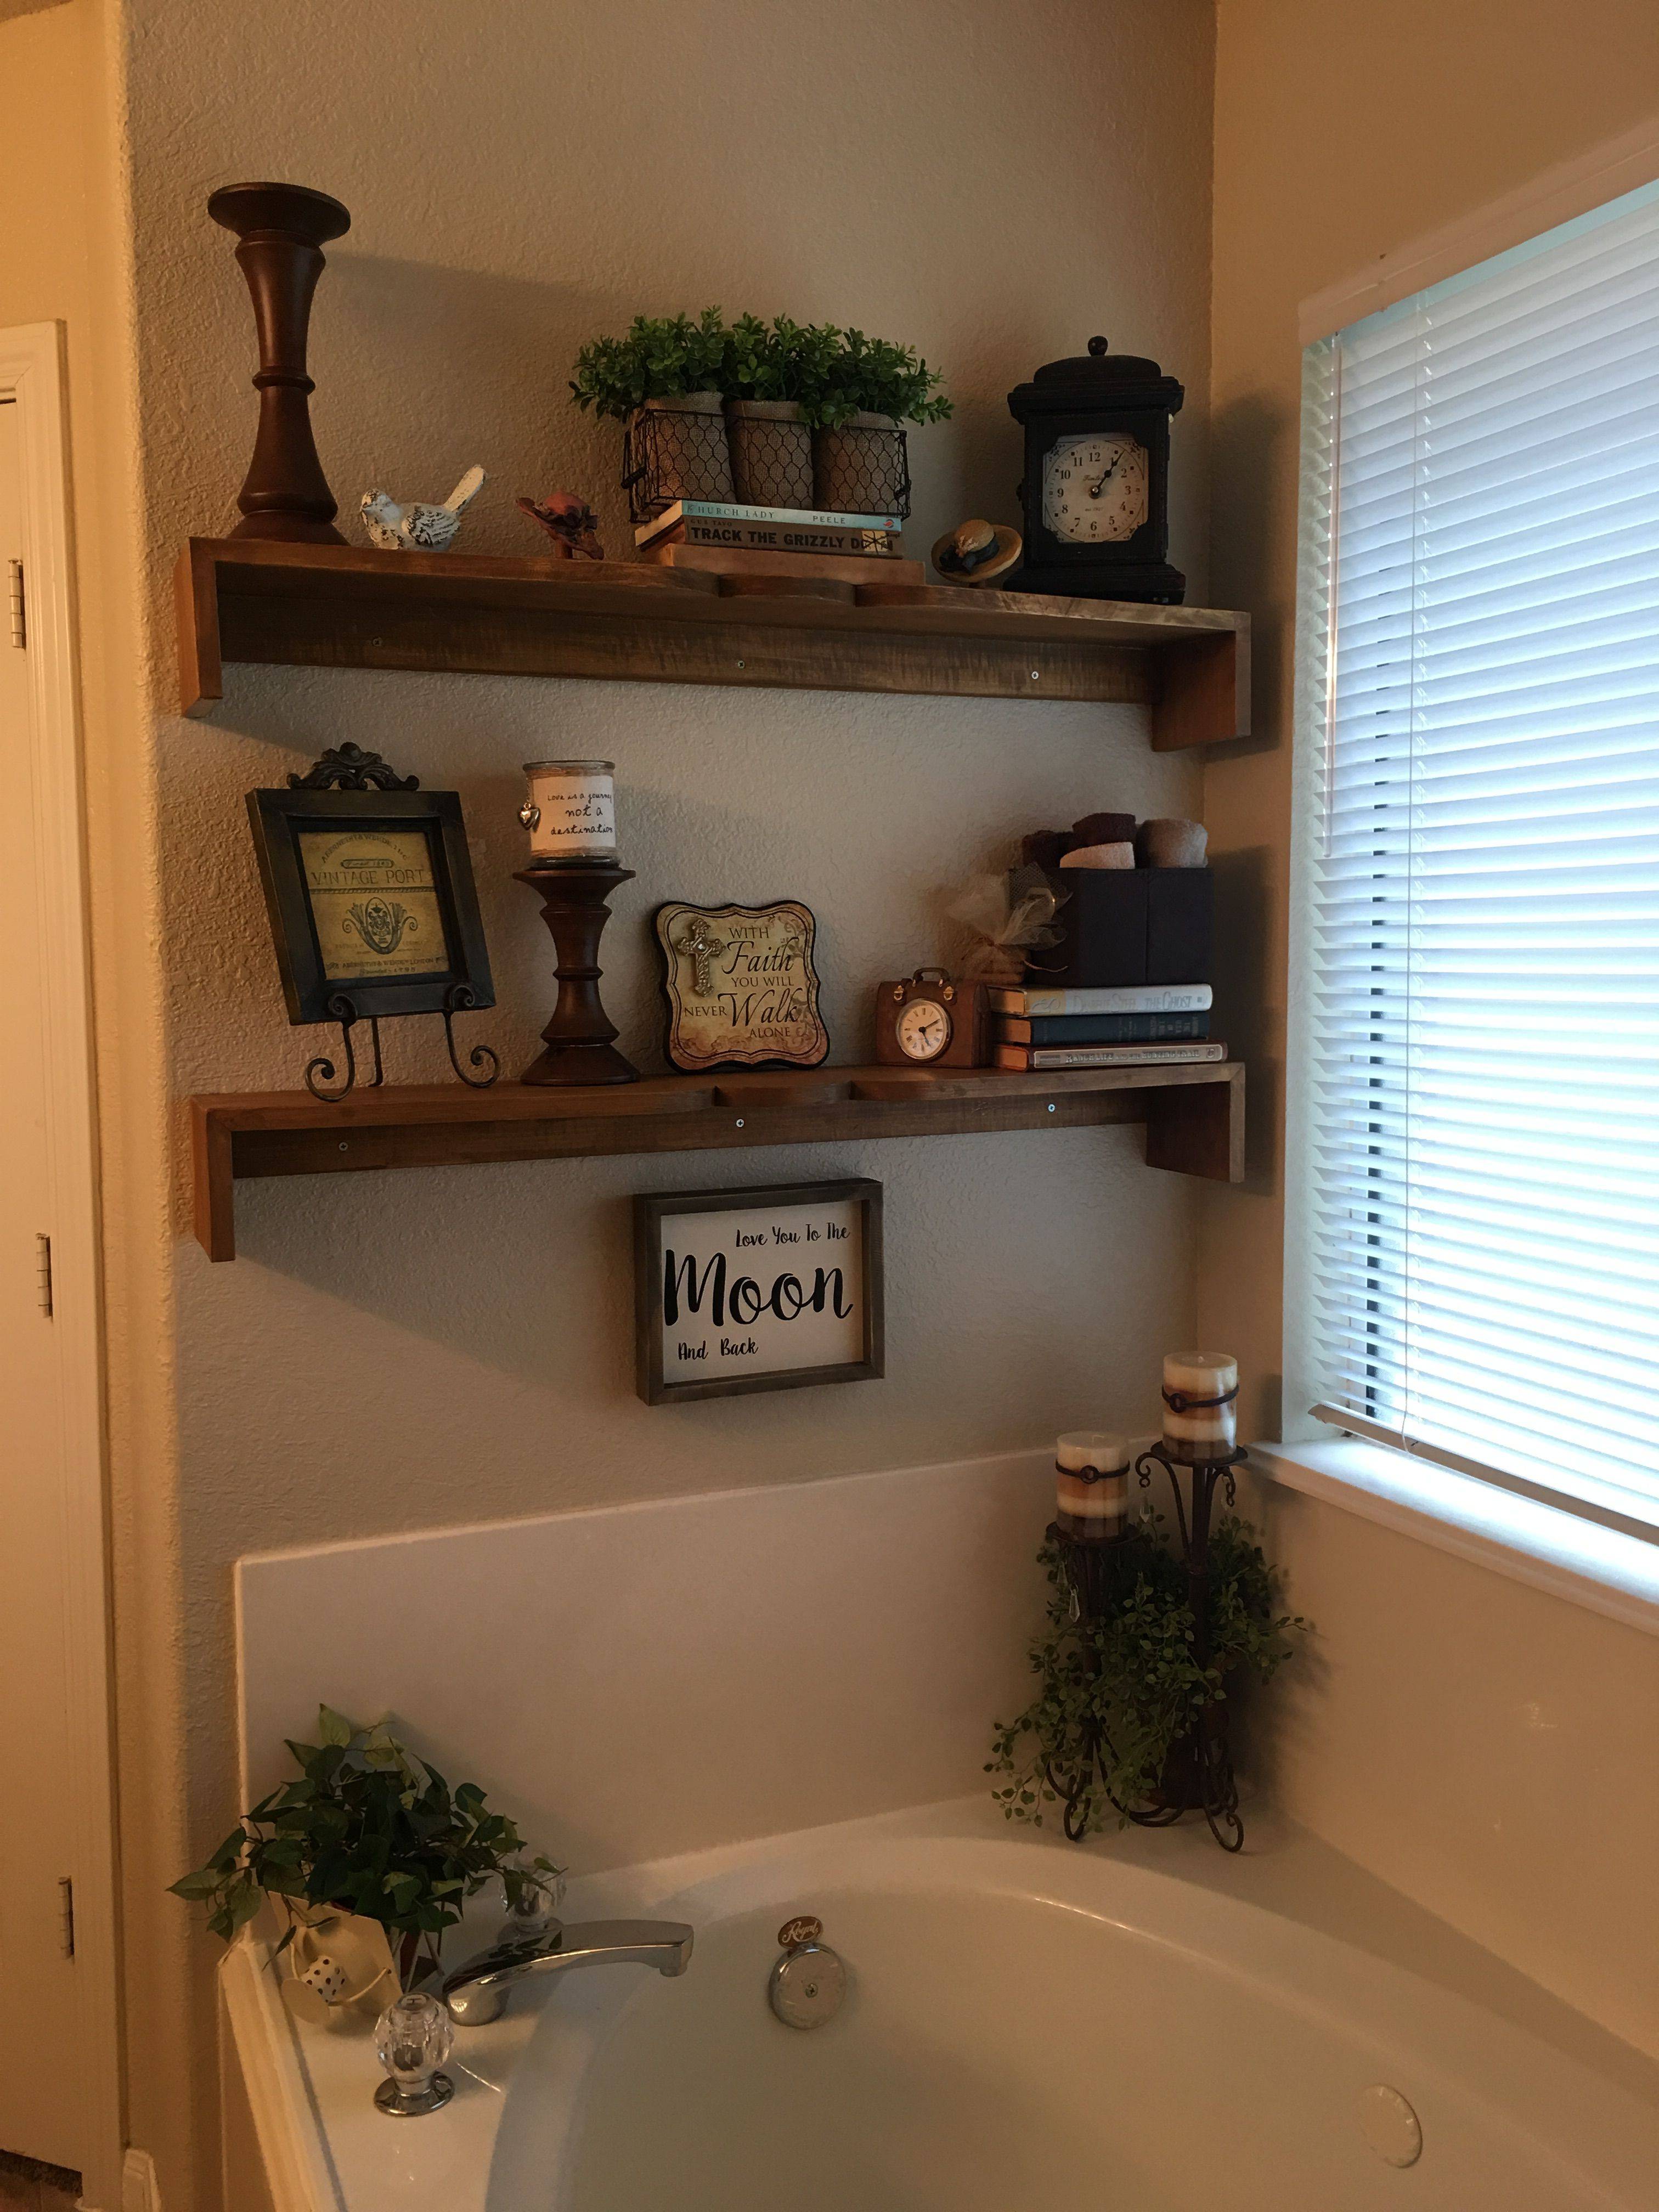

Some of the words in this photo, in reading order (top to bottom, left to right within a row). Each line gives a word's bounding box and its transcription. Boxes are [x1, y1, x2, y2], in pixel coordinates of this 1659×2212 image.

[1074, 458, 1083, 467] 11
[1089, 452, 1101, 462] 12
[1060, 470, 1071, 479] 10
[1121, 468, 1127, 478] 2
[1057, 488, 1064, 498] 9
[1125, 486, 1131, 495] 3
[1062, 504, 1069, 514] 8
[1119, 501, 1126, 511] 4
[687, 504, 738, 516] CHURCH
[746, 510, 775, 518] LADY
[812, 515, 846, 524] PEELE
[1075, 517, 1081, 527] 7
[1090, 521, 1097, 531] 6
[1109, 516, 1115, 525] 5
[691, 527, 742, 542] TRACK
[748, 531, 777, 544] THE
[783, 533, 845, 549] GRIZZLY
[565, 804, 591, 817] not
[596, 807, 603, 816] a
[551, 823, 613, 835] destination
[311, 870, 379, 885] VINTAGE
[386, 868, 424, 884] PORT
[728, 927, 770, 939] WITH
[721, 936, 800, 974] Faith
[731, 977, 758, 988] YOU
[763, 976, 794, 987] WILL
[684, 1005, 727, 1017] NEVER
[717, 987, 803, 1027] Walk
[1162, 991, 1192, 1011] GHOST
[749, 1026, 791, 1038] ALONE
[736, 1229, 768, 1248] Love
[772, 1226, 801, 1245] You
[805, 1223, 821, 1242] To
[826, 1222, 850, 1240] The
[664, 1249, 854, 1327] Moon
[678, 1340, 709, 1361] And
[720, 1337, 759, 1357] Back
